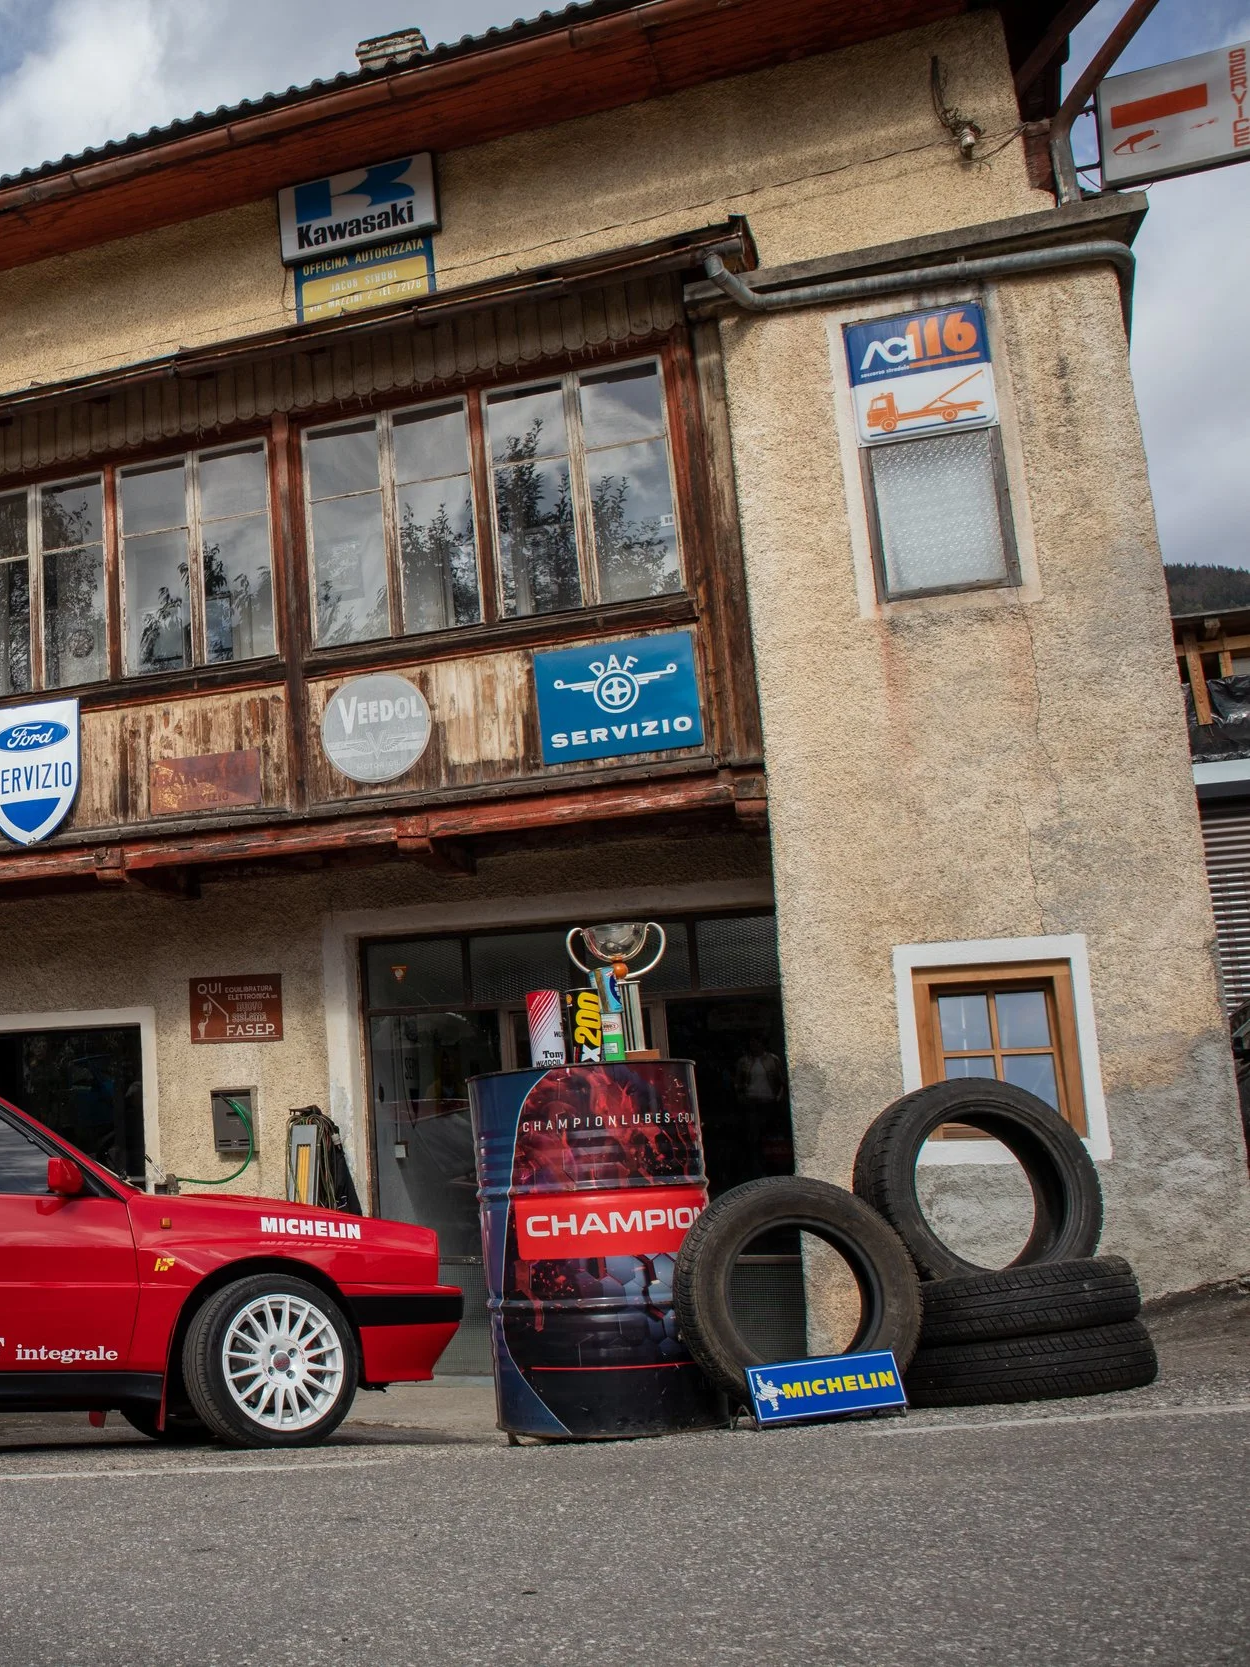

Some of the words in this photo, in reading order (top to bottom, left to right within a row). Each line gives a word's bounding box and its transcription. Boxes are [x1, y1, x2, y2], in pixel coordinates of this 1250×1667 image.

[1228, 48, 1250, 148] SERVICE
[297, 200, 414, 249] Kawasaki
[302, 255, 349, 277] OFFICINA
[354, 238, 424, 265] AUTORIZZATA
[860, 334, 917, 370] ACI
[905, 312, 978, 358] 116
[588, 654, 639, 677] DAF
[336, 695, 423, 735] VEEDOL
[6, 724, 53, 749] Ford
[550, 715, 694, 750] SERVIZIO
[197, 982, 222, 995] QUI
[224, 985, 273, 994] EQUILIBRATURA
[227, 993, 270, 1001] ELETTRONICA
[542, 1050, 564, 1060] Tony
[522, 1113, 696, 1133] CHAMPIONLUBES.COM
[259, 1216, 362, 1240] MICHELIN
[15, 1344, 118, 1365] integrale
[781, 1369, 896, 1400] MICHELIN
